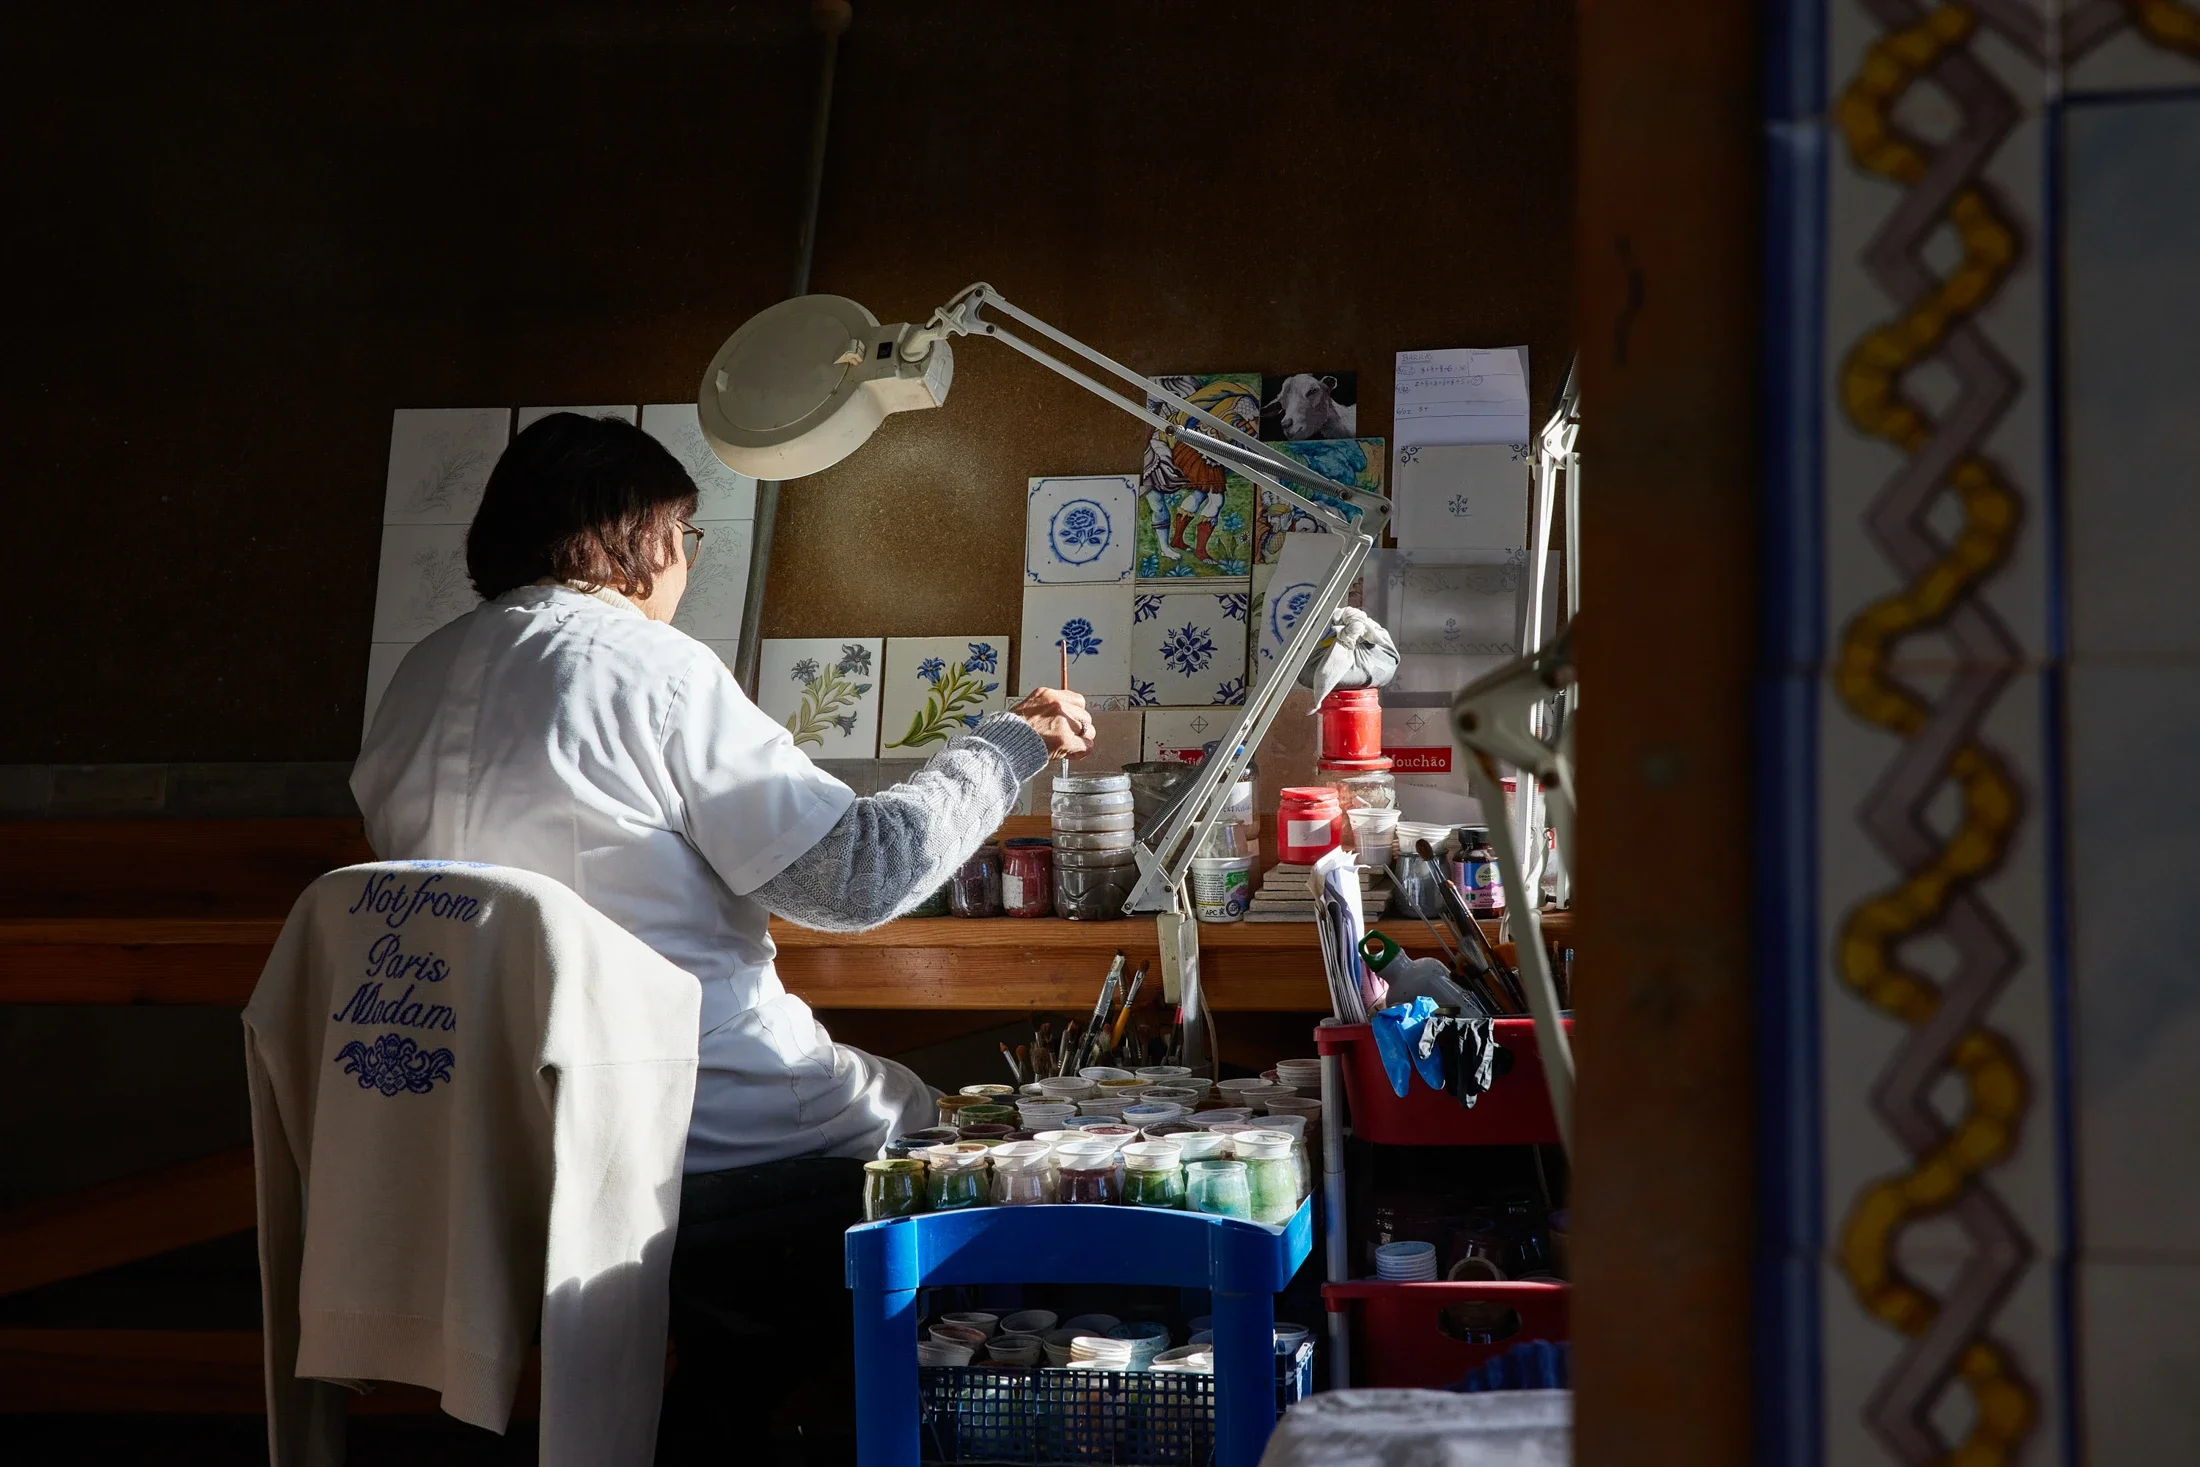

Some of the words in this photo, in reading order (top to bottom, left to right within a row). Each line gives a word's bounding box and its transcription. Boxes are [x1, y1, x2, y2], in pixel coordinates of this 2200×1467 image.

[349, 872, 409, 915] Not
[386, 874, 480, 929] from
[366, 932, 451, 983] Paris
[333, 981, 457, 1032] Madam
